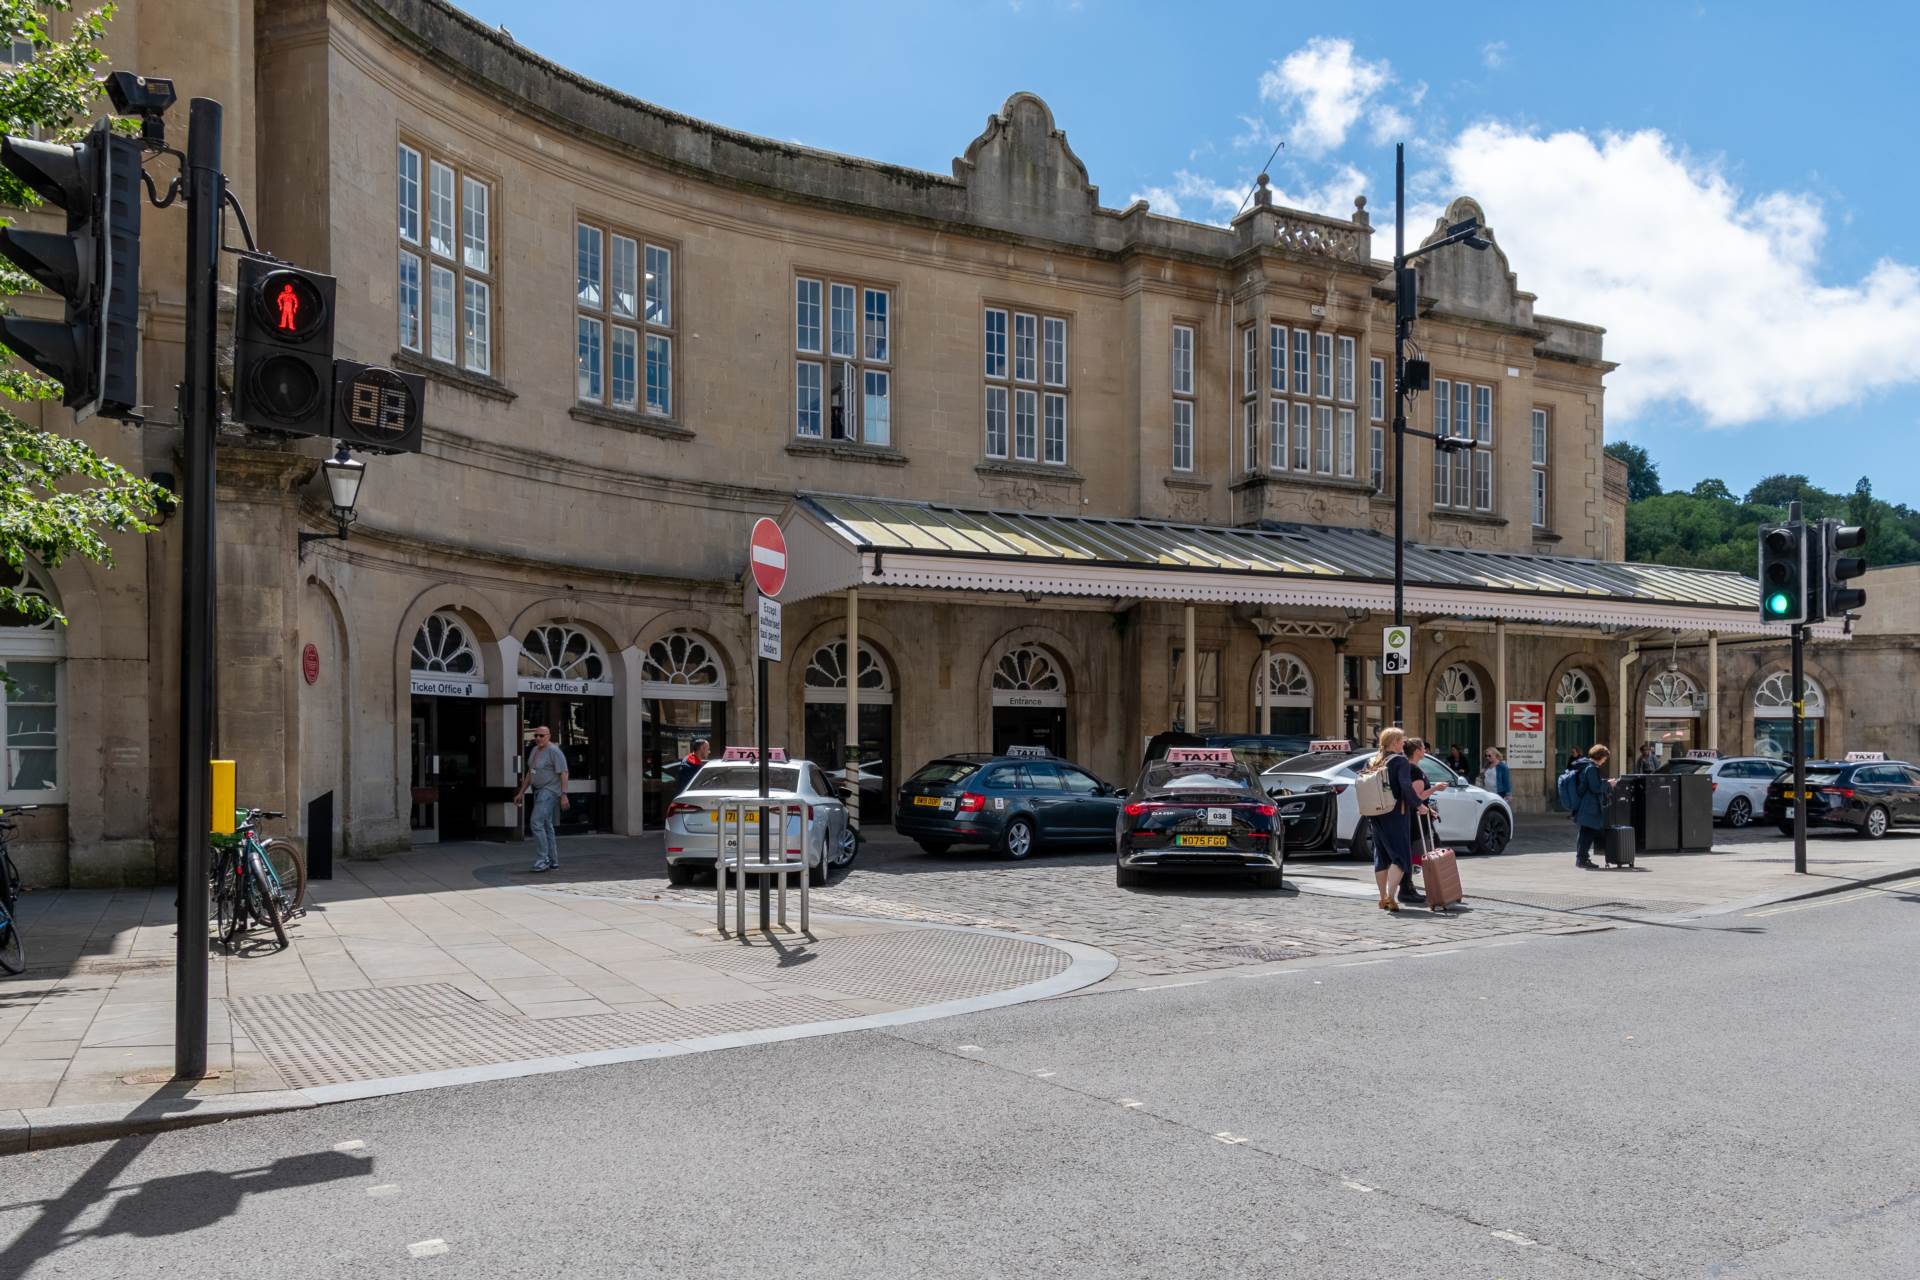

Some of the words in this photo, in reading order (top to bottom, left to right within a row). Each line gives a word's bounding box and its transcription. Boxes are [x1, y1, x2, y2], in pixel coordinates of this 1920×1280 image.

[763, 602, 777, 617] Except
[411, 682, 436, 693] Ticket
[438, 684, 462, 694] Office
[528, 681, 552, 691] Ticket
[554, 682, 578, 692] Office
[1009, 697, 1042, 706] Entrance
[736, 751, 773, 760] TAI
[1016, 749, 1038, 757] TAXI
[1181, 753, 1220, 761] TAXI
